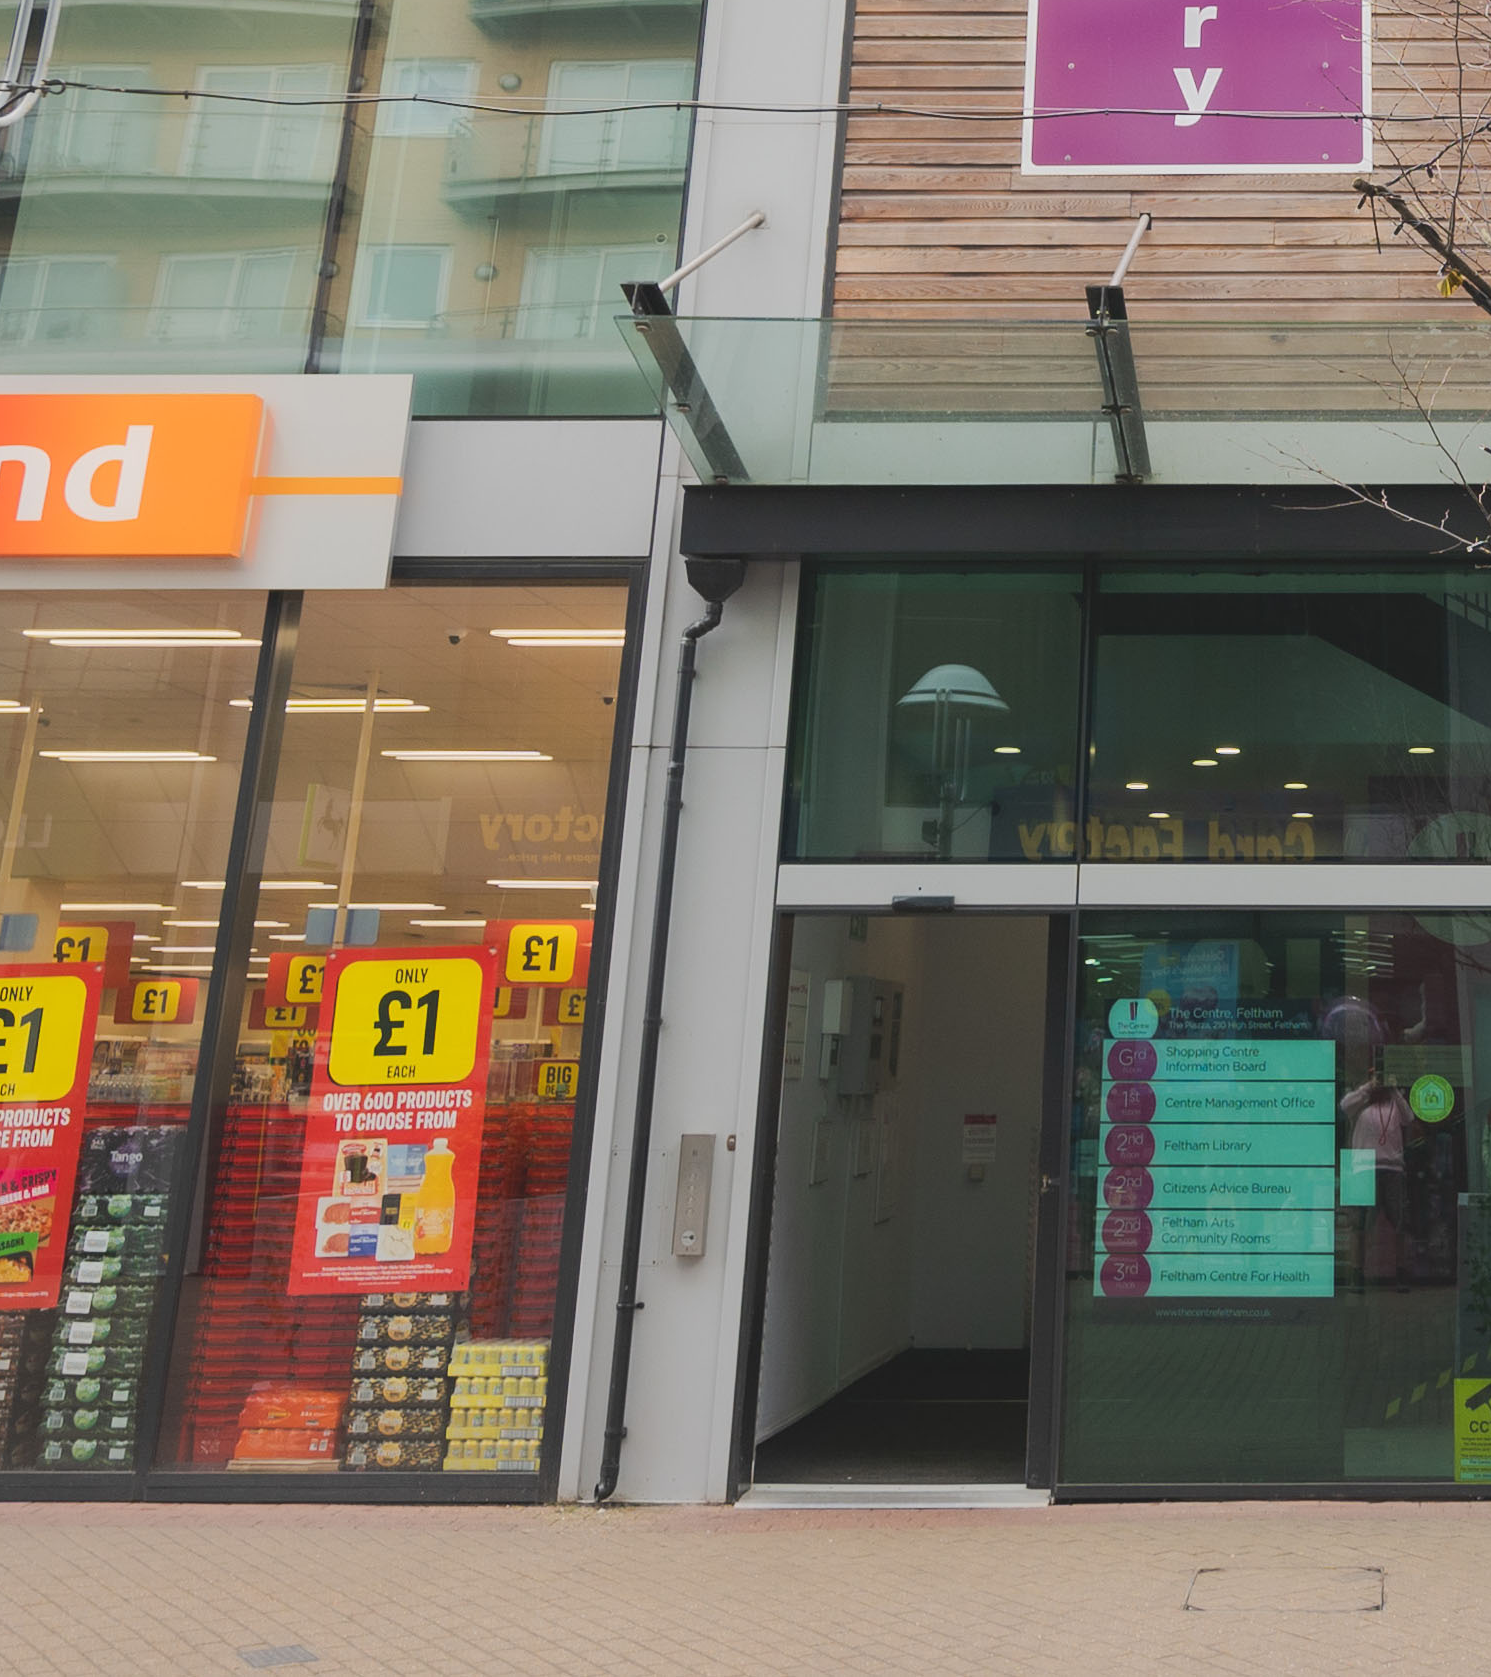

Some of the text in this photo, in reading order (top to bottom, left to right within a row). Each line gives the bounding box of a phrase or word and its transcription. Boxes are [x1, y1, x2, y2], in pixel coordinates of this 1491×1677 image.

[53, 937, 92, 963] £1
[522, 936, 559, 971] £1
[395, 968, 429, 984] ONLY
[0, 986, 34, 1002] ONLY
[142, 989, 167, 1014] £1
[1169, 1008, 1283, 1019] The Centre, Feltham
[373, 989, 440, 1057] £1
[1225, 1022, 1244, 1030] High
[1246, 1022, 1273, 1030] Street,
[1118, 1049, 1146, 1066] Grd
[1166, 1047, 1259, 1058] Shopping Centre
[387, 1065, 416, 1079] EACH
[546, 1066, 572, 1083] BIG
[1166, 1061, 1266, 1072] Information Board
[323, 1089, 472, 1111] OVER 600 PRODUCTS
[1123, 1091, 1140, 1107] 1st
[1165, 1098, 1315, 1110] Centre Management Office
[335, 1110, 457, 1132] TO CHOOSE FROM
[12, 1129, 54, 1148] FROM
[1116, 1133, 1143, 1151] 2nd
[1164, 1141, 1252, 1152] Feltham Library
[110, 1150, 143, 1164] Tango
[1115, 1175, 1142, 1193] 2nd
[1163, 1183, 1291, 1194] Citizens Advice Bureau
[1162, 1217, 1234, 1228] Feltham Arts
[1162, 1233, 1270, 1245] Community Rooms
[1114, 1263, 1138, 1281] 3rd
[1161, 1271, 1309, 1282] Feltham Centre For Health
